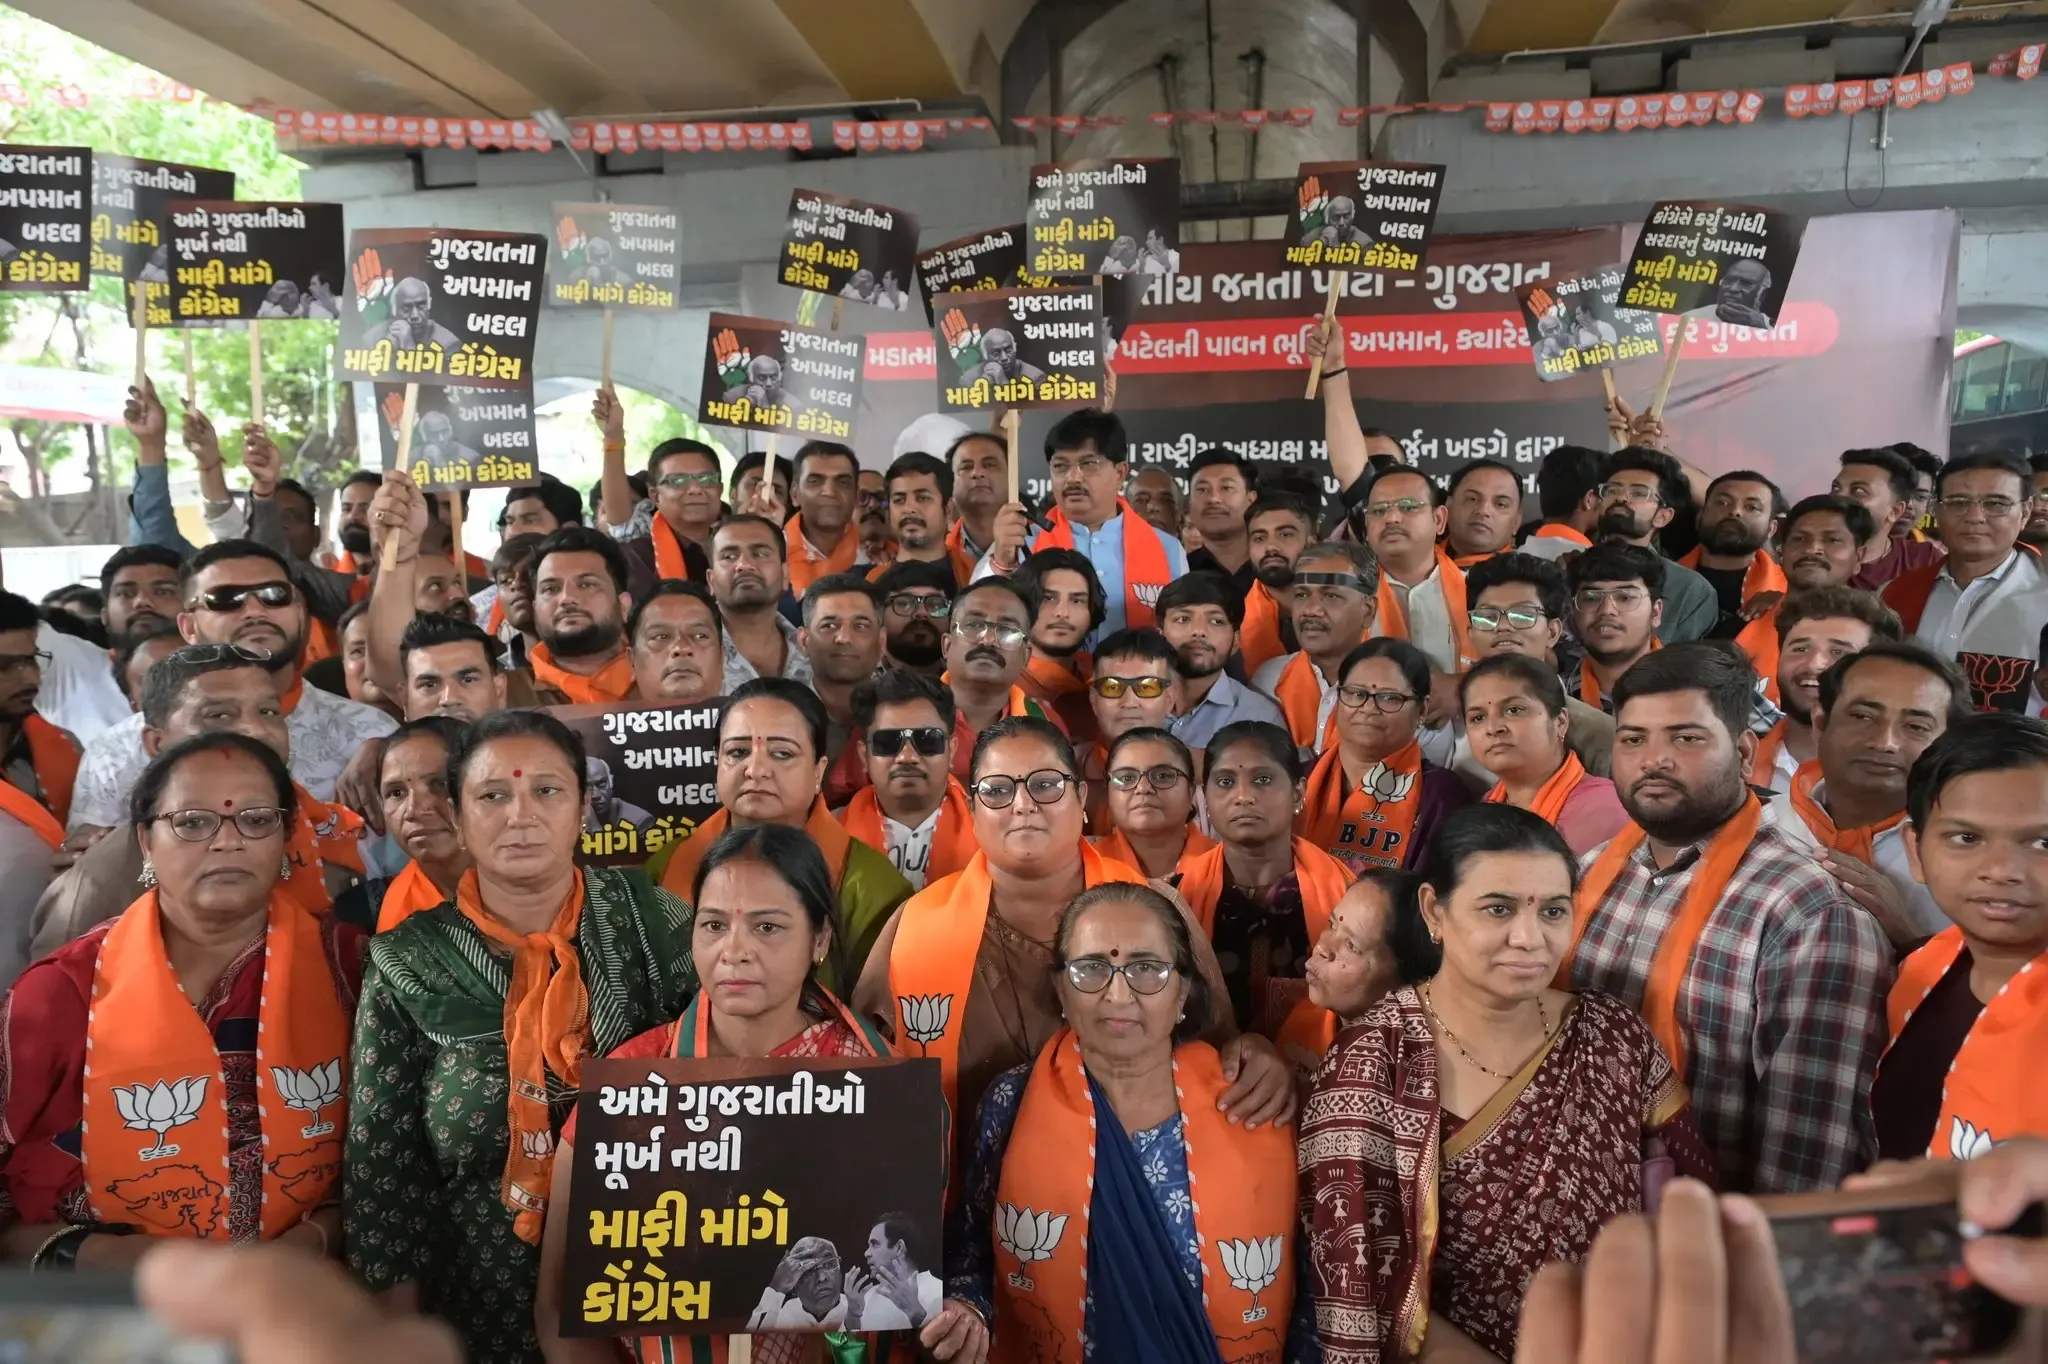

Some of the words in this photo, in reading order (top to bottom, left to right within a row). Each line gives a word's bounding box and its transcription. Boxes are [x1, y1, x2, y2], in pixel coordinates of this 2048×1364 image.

[1036, 170, 1063, 189] અમે
[1066, 164, 1146, 194] ગુજરાતીઓ
[1358, 168, 1436, 190] ગુજરાતના
[797, 197, 821, 214] અમે
[823, 204, 892, 230] ગુજરાતીઓ
[1035, 191, 1062, 218] મૂર્ખ
[1065, 190, 1093, 210] નથી
[1365, 194, 1430, 213] અપમાન
[22, 223, 80, 242] બદલ
[174, 207, 208, 228] અમે
[212, 207, 305, 235] ગુજરાતીઓ
[609, 212, 675, 233] ગુજરાતના
[792, 217, 819, 238] મૂર્ખ
[819, 223, 845, 240] નથી
[1035, 218, 1074, 245] માફી
[1079, 218, 1116, 240] માંગે
[1380, 222, 1424, 239] બદલ
[175, 231, 208, 260] મૂર્ખ
[212, 232, 246, 252] નથી
[430, 238, 536, 269] ગુજરાતના
[620, 236, 674, 253] અપમાન
[786, 241, 826, 266] માફી
[827, 247, 860, 270] માંગે
[922, 252, 945, 269] અમે
[947, 231, 1013, 266] ગુજરાતીઓ
[1287, 240, 1323, 266] માફી
[1324, 243, 1360, 263] માંગે
[1364, 244, 1418, 270] કોંગ્રેસ
[1702, 238, 1766, 259] અપમાન
[10, 250, 80, 282] કોંગ્રેસ
[637, 263, 673, 277] બદલ
[1035, 248, 1085, 271] કોંગ્રેસ
[1635, 255, 1677, 281] માફી
[1677, 260, 1718, 283] માંગે
[177, 260, 224, 290] માફી
[230, 261, 272, 284] માંગે
[443, 275, 531, 300] અપમાન
[784, 263, 829, 290] કોંગ્રેસ
[925, 266, 948, 291] મૂર્ખ
[950, 260, 975, 279] નથી
[179, 286, 240, 316] કોંગ્રેસ
[558, 280, 590, 302] માફી
[592, 282, 624, 302] માંગે
[627, 283, 672, 306] કોંગ્રેસ
[1625, 280, 1677, 309] કોંગ્રેસ
[1009, 295, 1093, 320] ગુજરાતના
[467, 313, 526, 336] બદલ
[1024, 323, 1093, 339] અપમાન
[781, 330, 857, 357] ગુજરાતના
[1120, 329, 1198, 359] પટેલની
[1206, 336, 1266, 356] પાવન
[1350, 331, 1448, 353] અપમાન,
[1545, 348, 1582, 372] માફી
[1582, 342, 1615, 365] માંગે
[1618, 337, 1658, 360] કોંગ્રેસ
[345, 340, 392, 376] માફી
[397, 342, 443, 372] માંગે
[450, 342, 521, 380] કોંગ્રેસ
[792, 358, 854, 382] અપમાન
[1049, 351, 1094, 366] બદલ
[810, 388, 852, 407] બદલ
[947, 377, 989, 407] માફી
[994, 376, 1035, 401] માંગે
[1040, 374, 1096, 400] કોંગ્રેસ
[459, 404, 526, 421] અપમાન
[708, 398, 751, 424] માફી
[753, 405, 792, 427] માંગે
[798, 409, 850, 438] કોંગ્રેસ
[484, 432, 528, 447] બદલ
[1445, 429, 1507, 458] ખડગે
[435, 460, 473, 482] માંગે
[477, 456, 532, 481] કોંગ્રેસ
[599, 1072, 668, 1115] અમે
[678, 1071, 864, 1131] ગુજરાતીઓ
[595, 1126, 665, 1189] મૂર્ખ
[671, 1126, 741, 1171] નથી
[590, 1191, 687, 1257] માફી
[701, 1190, 788, 1246] માંગે
[584, 1260, 710, 1322] કોંગ્રેસ
